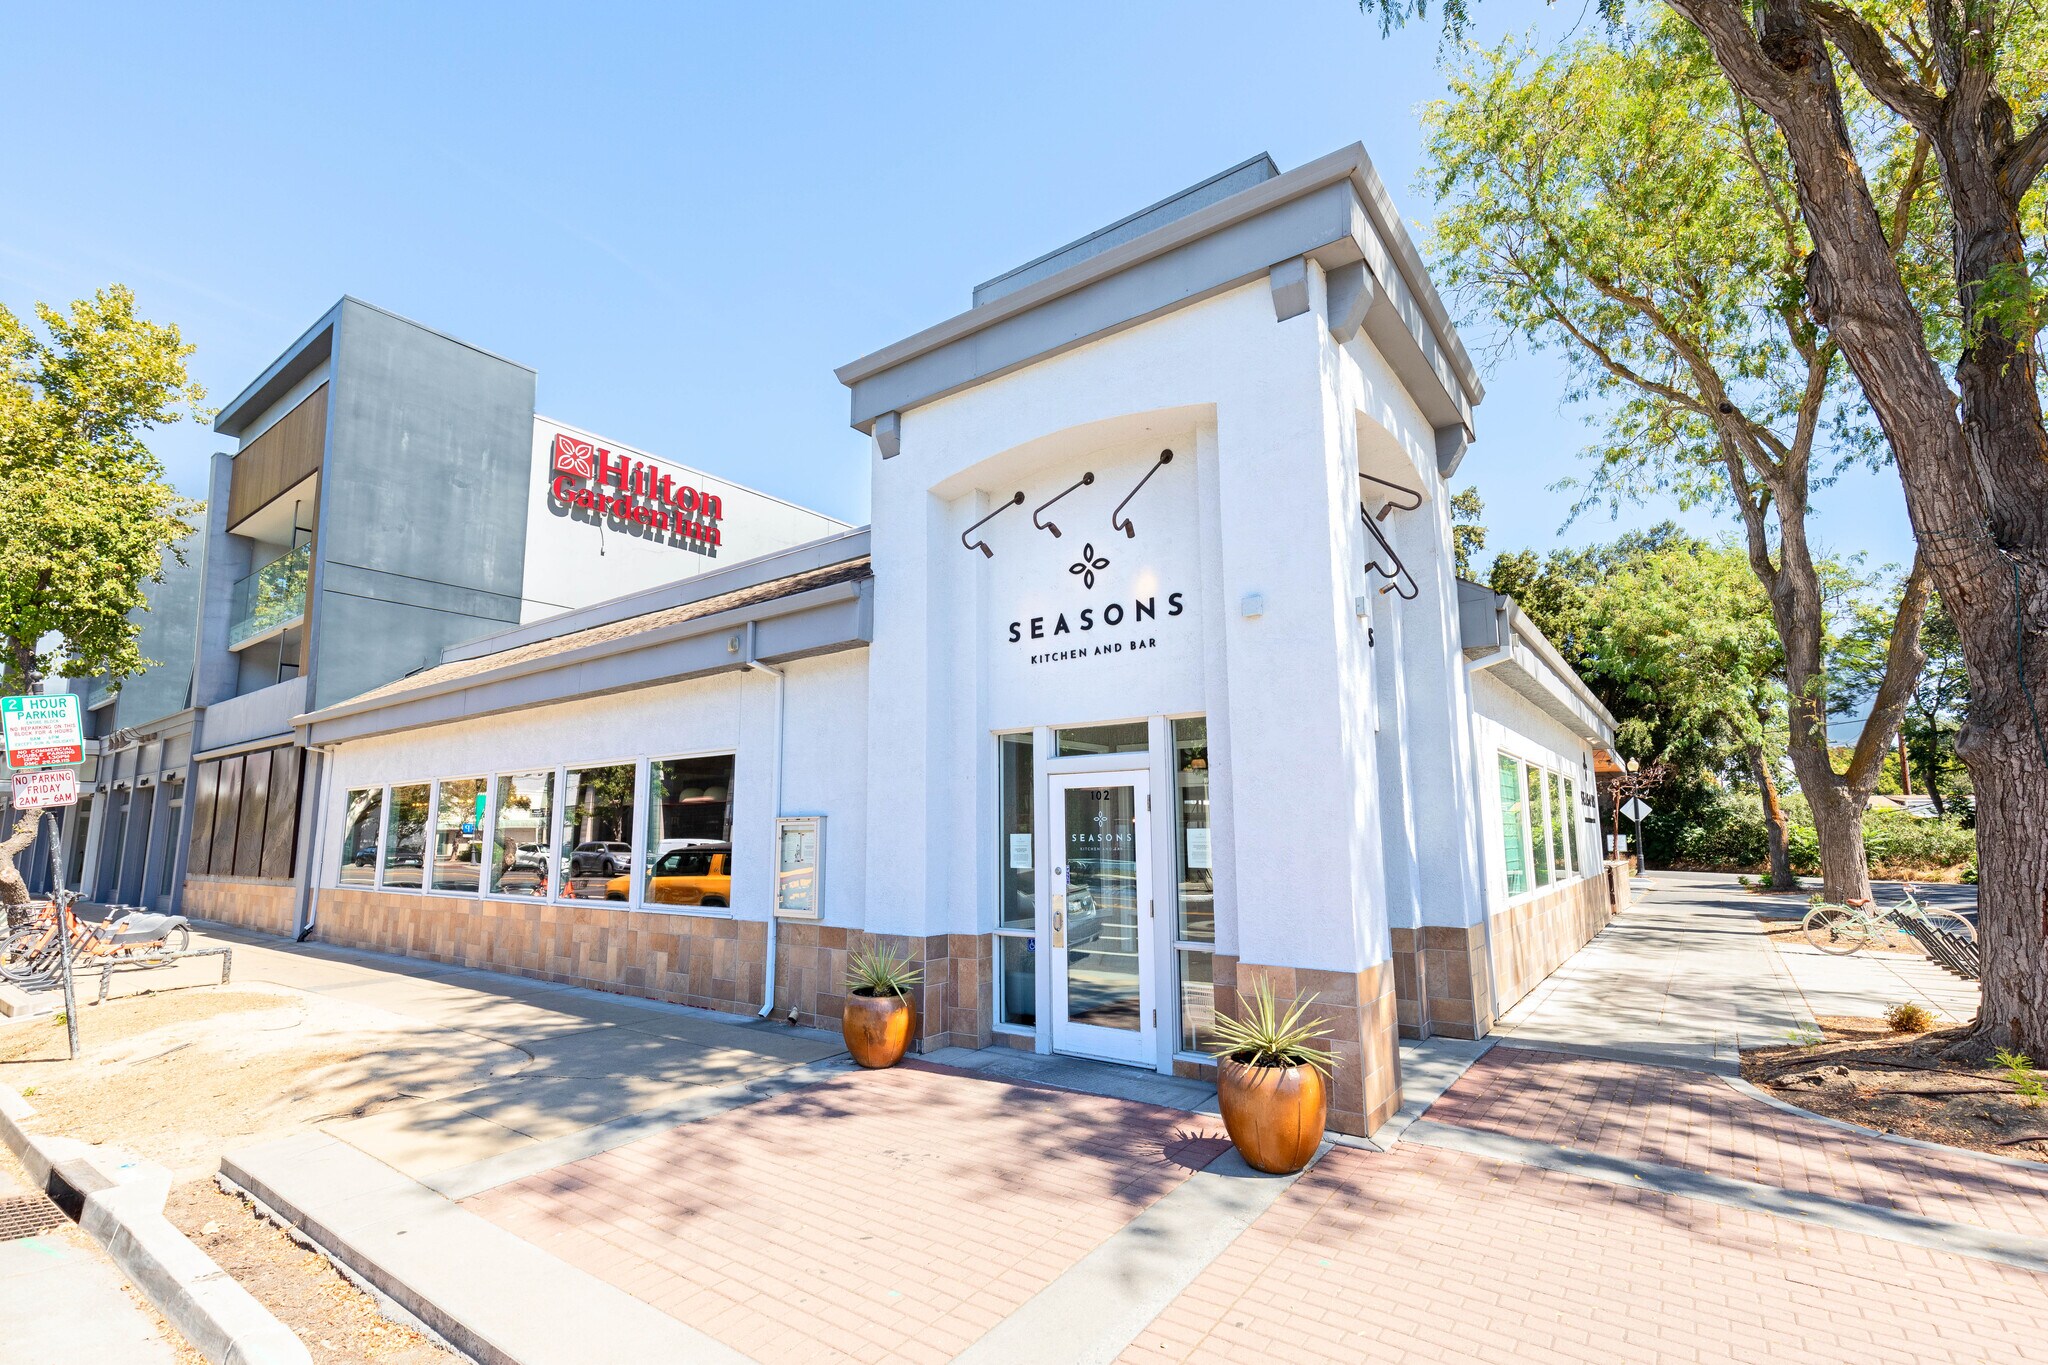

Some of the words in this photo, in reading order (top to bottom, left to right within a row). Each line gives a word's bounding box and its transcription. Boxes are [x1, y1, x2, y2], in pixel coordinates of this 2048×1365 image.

[596, 447, 724, 521] Hilton
[553, 475, 670, 531] Garden
[673, 509, 723, 547] Inn
[1008, 592, 1184, 643] SEASONS
[1031, 648, 1087, 664] KITCHEN
[1094, 643, 1122, 656] AND
[1130, 638, 1157, 651] BAR
[8, 699, 18, 710] 2
[30, 698, 67, 709] HOUR
[17, 710, 66, 720] PARKING
[30, 746, 73, 754] COMMERCIAL
[15, 775, 28, 785] NO
[32, 772, 71, 783] PARKING
[27, 783, 61, 795] FRIDAY
[19, 796, 38, 806] 2AM
[54, 793, 72, 802] 6AM
[1090, 790, 1110, 801] 102
[1071, 833, 1132, 842] SEASONS
